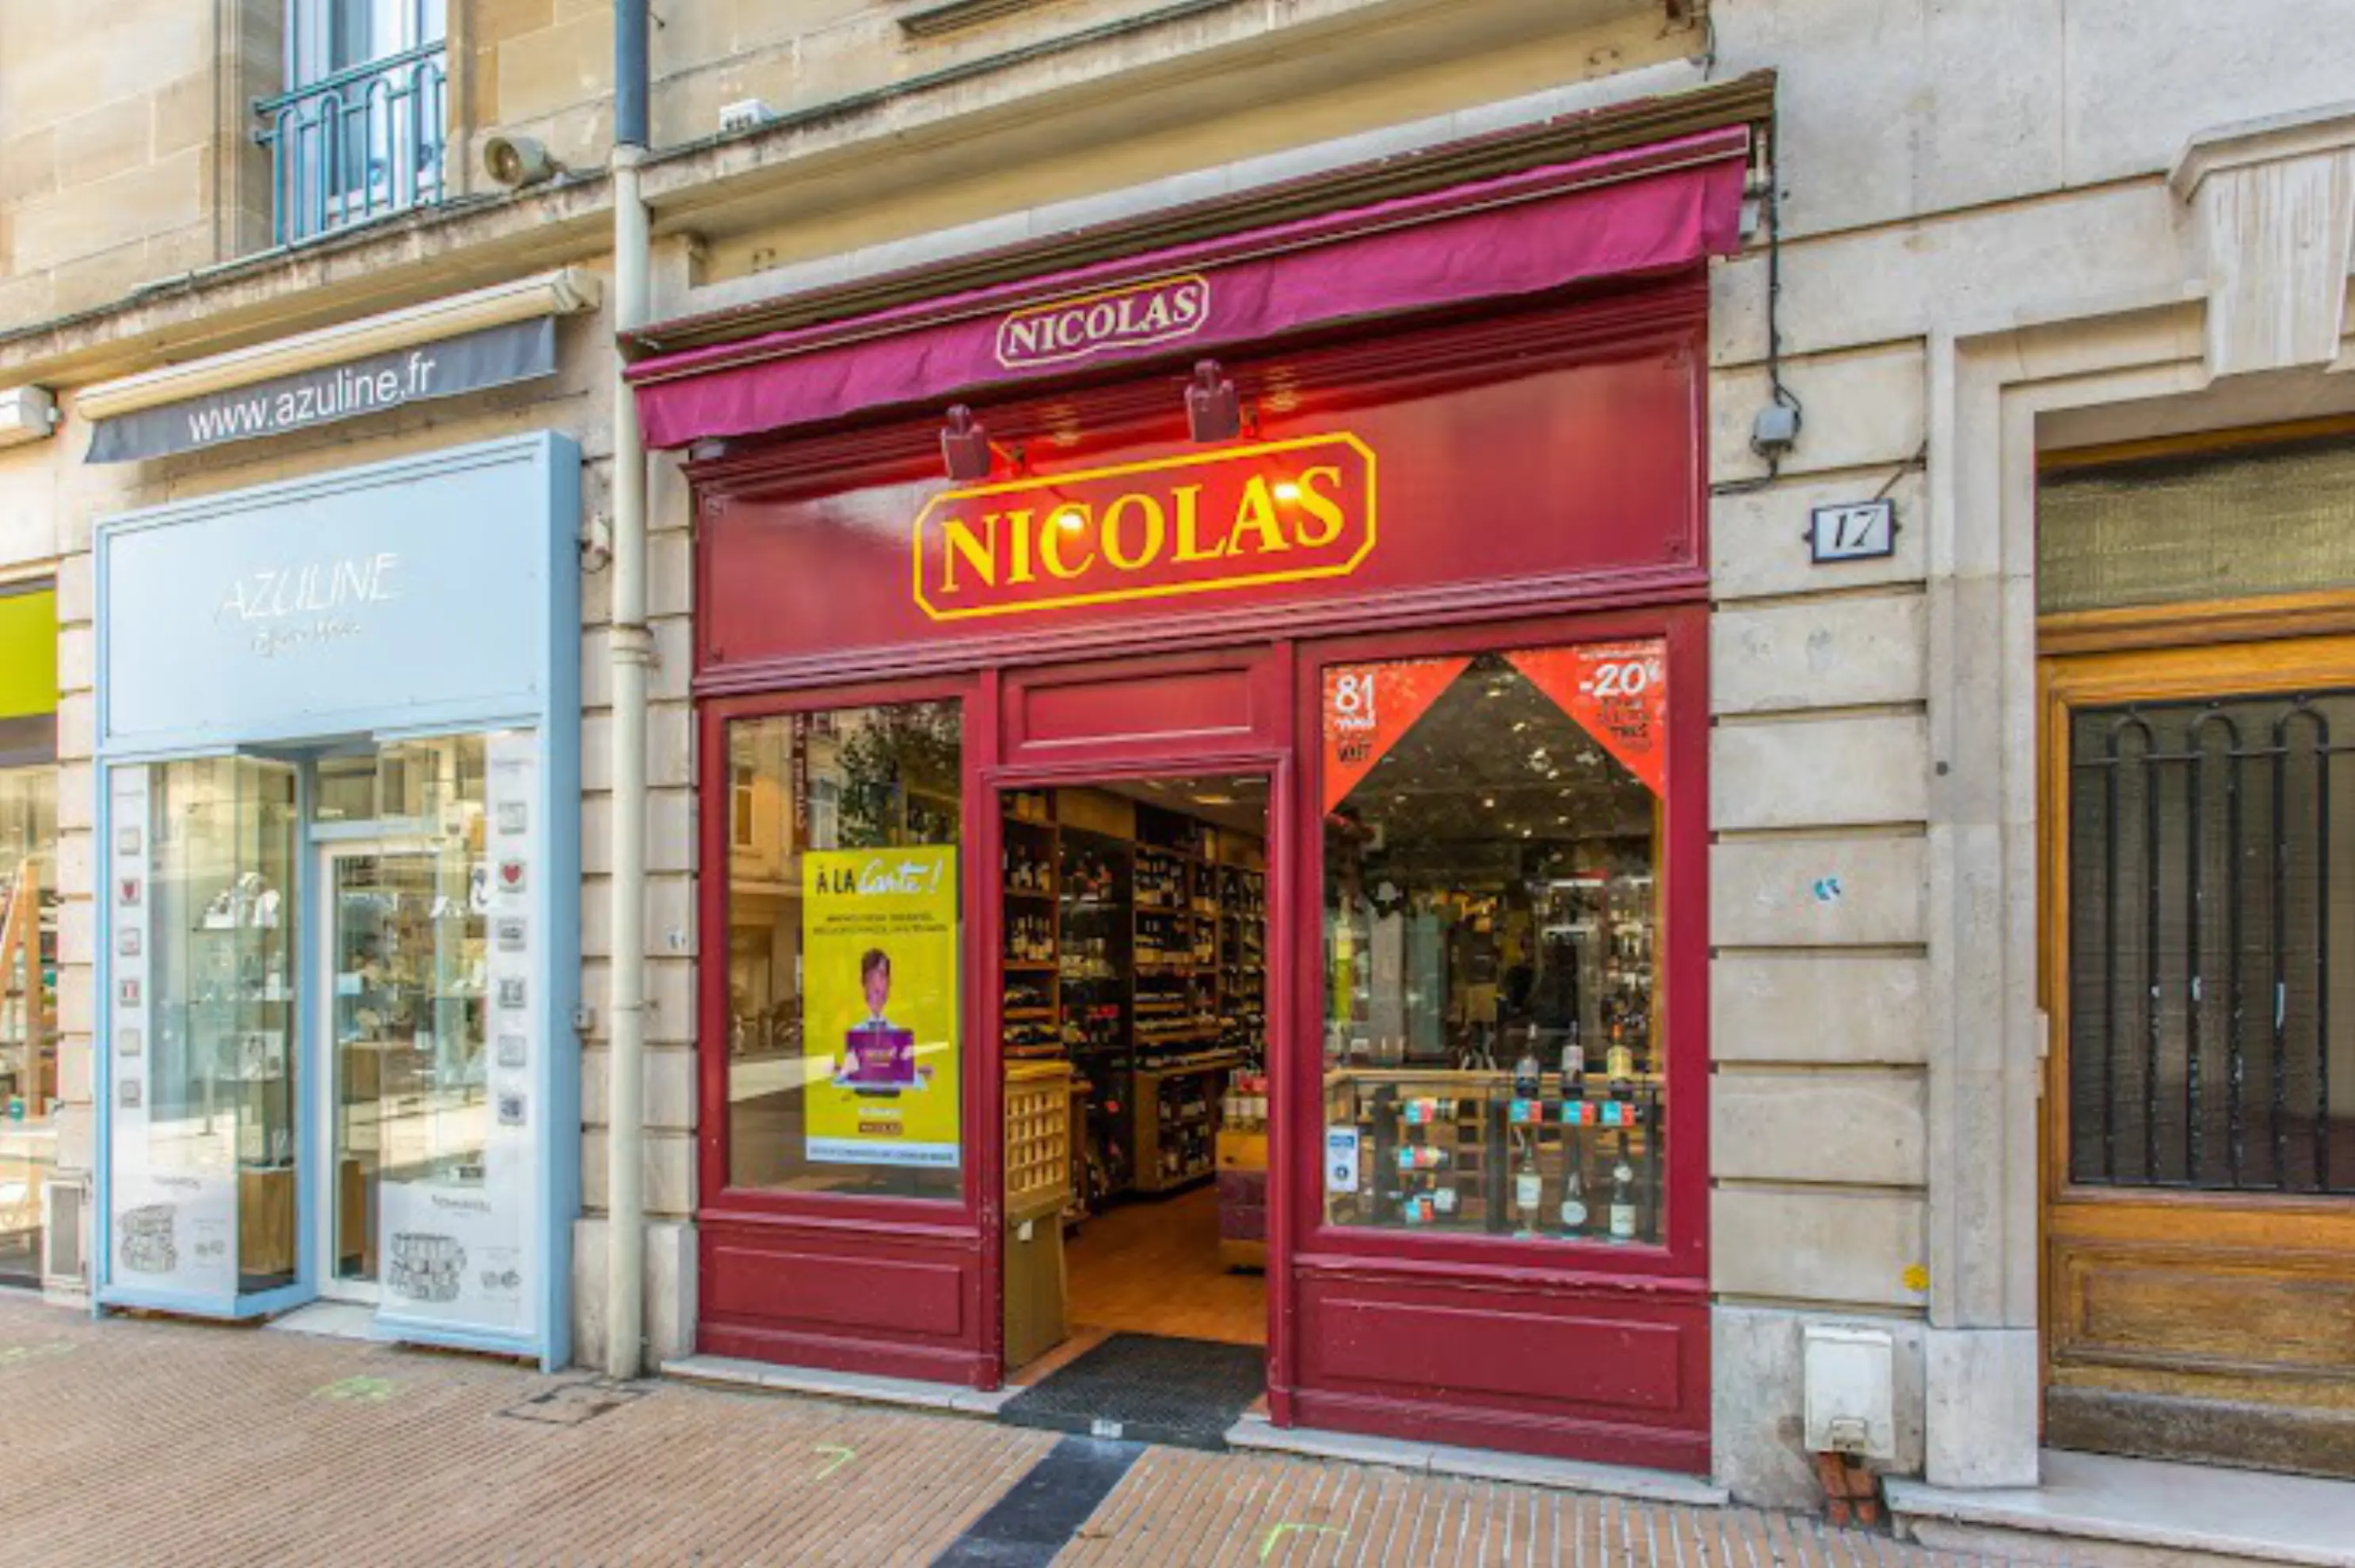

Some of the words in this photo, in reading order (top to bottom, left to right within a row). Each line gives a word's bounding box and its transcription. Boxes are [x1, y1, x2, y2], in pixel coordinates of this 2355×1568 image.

[1007, 287, 1199, 356] NICOLAS
[188, 352, 435, 442] www.azuline.fr
[939, 466, 1345, 593] NICOLAS
[1835, 507, 1881, 548] 17
[214, 551, 398, 621] AZULINE
[834, 869, 855, 894] LA
